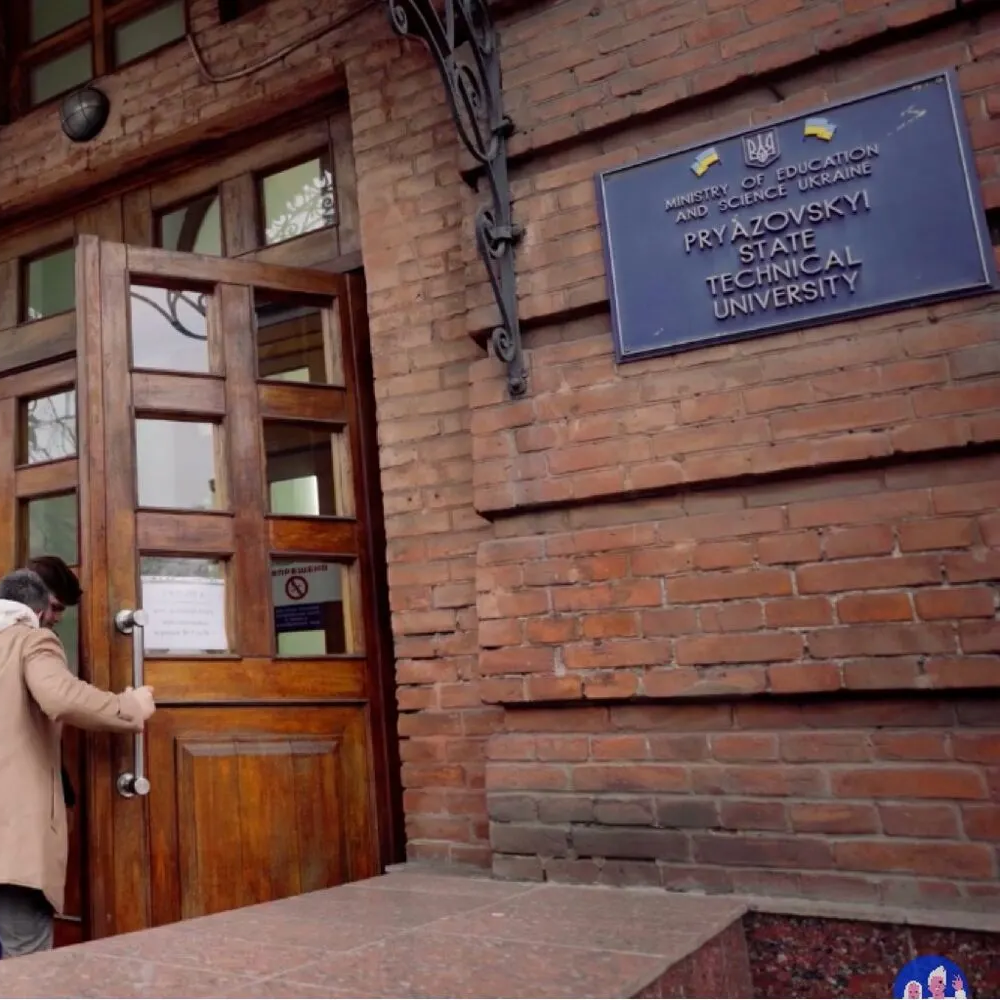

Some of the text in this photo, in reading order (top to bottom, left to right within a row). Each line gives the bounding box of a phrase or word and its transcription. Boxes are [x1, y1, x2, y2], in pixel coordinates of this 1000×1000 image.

[664, 143, 880, 212] MINISTRY OF EDUCATION
[675, 162, 872, 225] AND SCIENCE UKRAINE
[706, 246, 862, 296] TECHNICAL
[739, 229, 816, 264] STATE
[713, 271, 858, 320] UNIVERSITY
